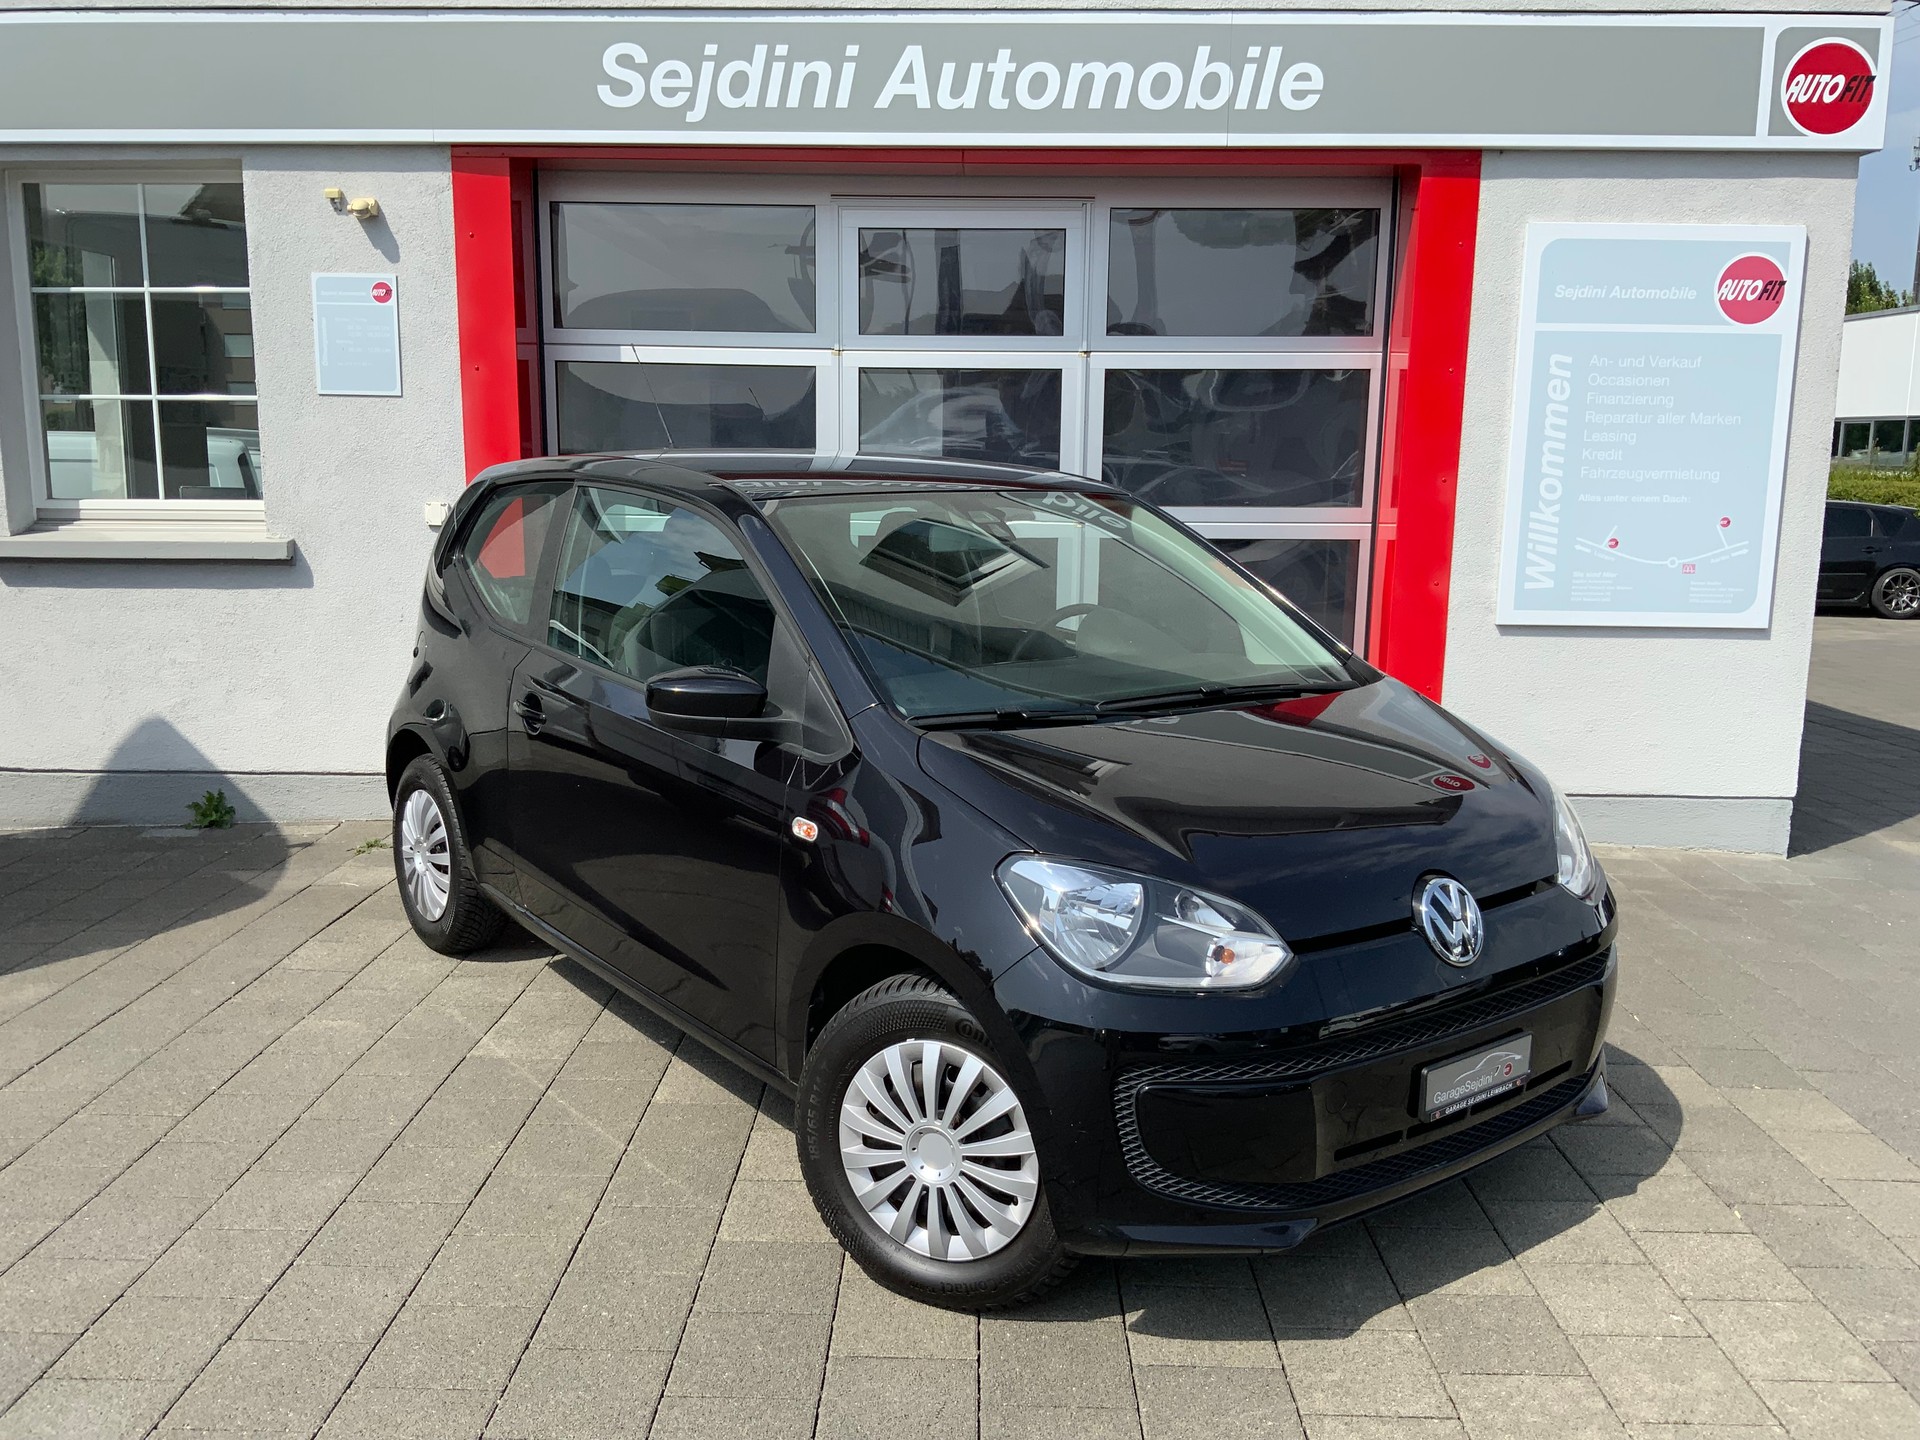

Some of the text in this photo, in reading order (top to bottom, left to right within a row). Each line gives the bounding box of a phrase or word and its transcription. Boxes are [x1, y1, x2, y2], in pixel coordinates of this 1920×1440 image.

[597, 42, 1324, 123] Sejdini Automobile
[1554, 284, 1697, 301] Sejdini Automobile
[1589, 354, 1702, 369] An- und Verkauf
[1587, 373, 1670, 386] Occasionen
[1586, 392, 1674, 408] Finanzierung
[1585, 410, 1742, 425] Reparatur aller Marken
[1583, 429, 1637, 445] Leasing
[1582, 448, 1623, 461] Kredit
[1523, 353, 1573, 591] Willkommen
[1580, 466, 1720, 483] Fahrzeugvermietung
[1578, 493, 1601, 502] Alles
[1603, 494, 1628, 502] unter
[1631, 495, 1660, 503] einem
[1434, 1072, 1493, 1104] GarageSejdini
[1445, 1100, 1467, 1115] GARAGE
[1467, 1093, 1487, 1105] SEJDINI
